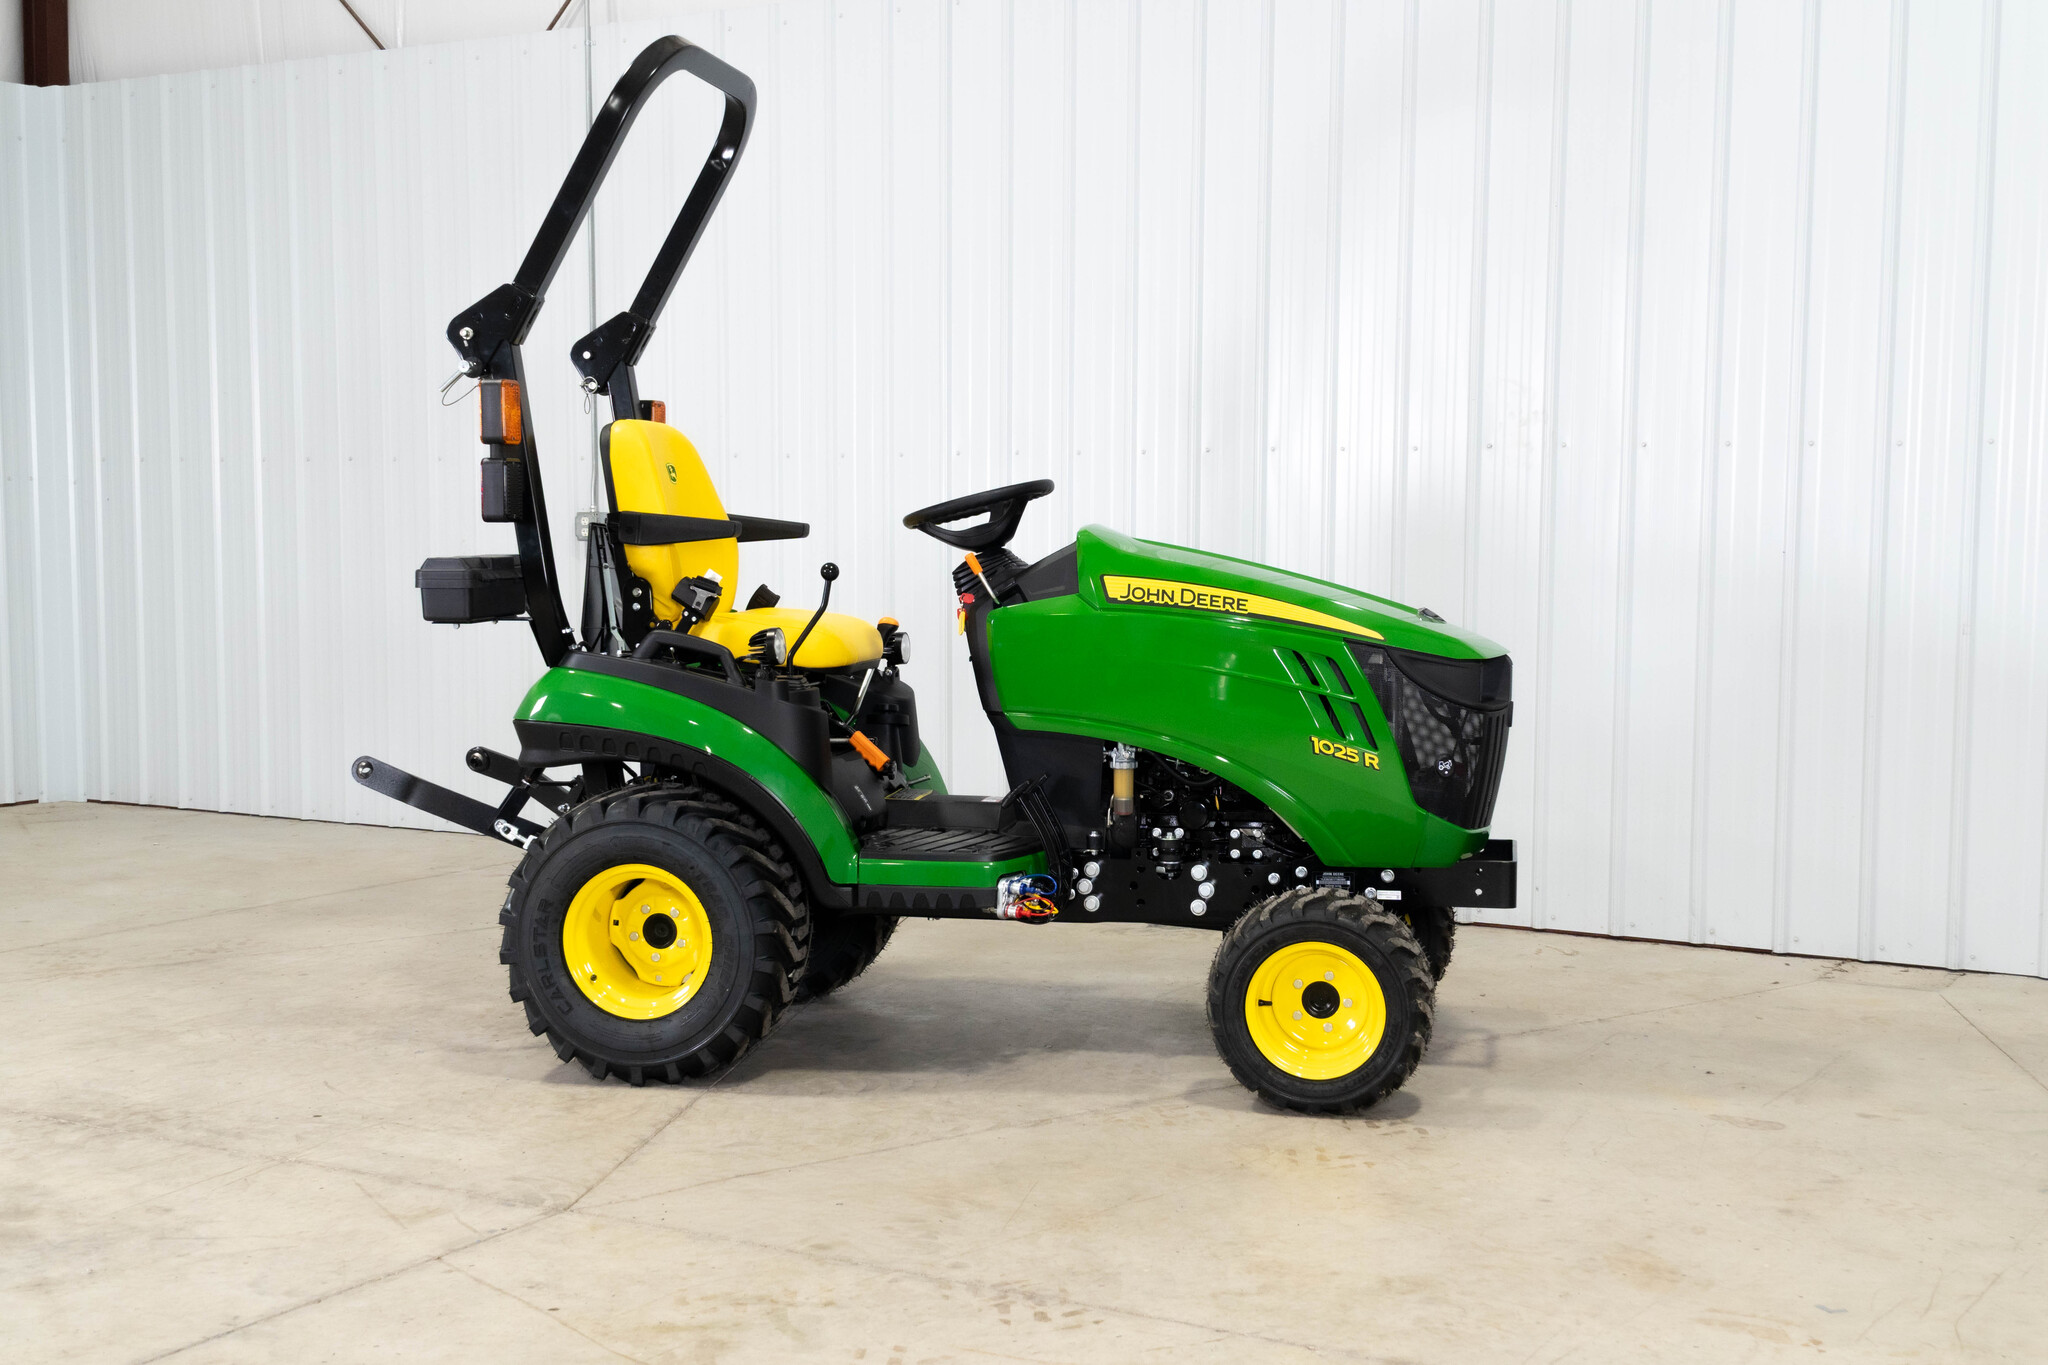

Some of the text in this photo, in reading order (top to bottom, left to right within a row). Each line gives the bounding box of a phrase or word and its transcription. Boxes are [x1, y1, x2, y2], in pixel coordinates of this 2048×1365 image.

[1119, 583, 1249, 612] JOHN DEERE
[1310, 735, 1380, 770] 1025 R
[532, 898, 573, 1016] CARLSTAR
